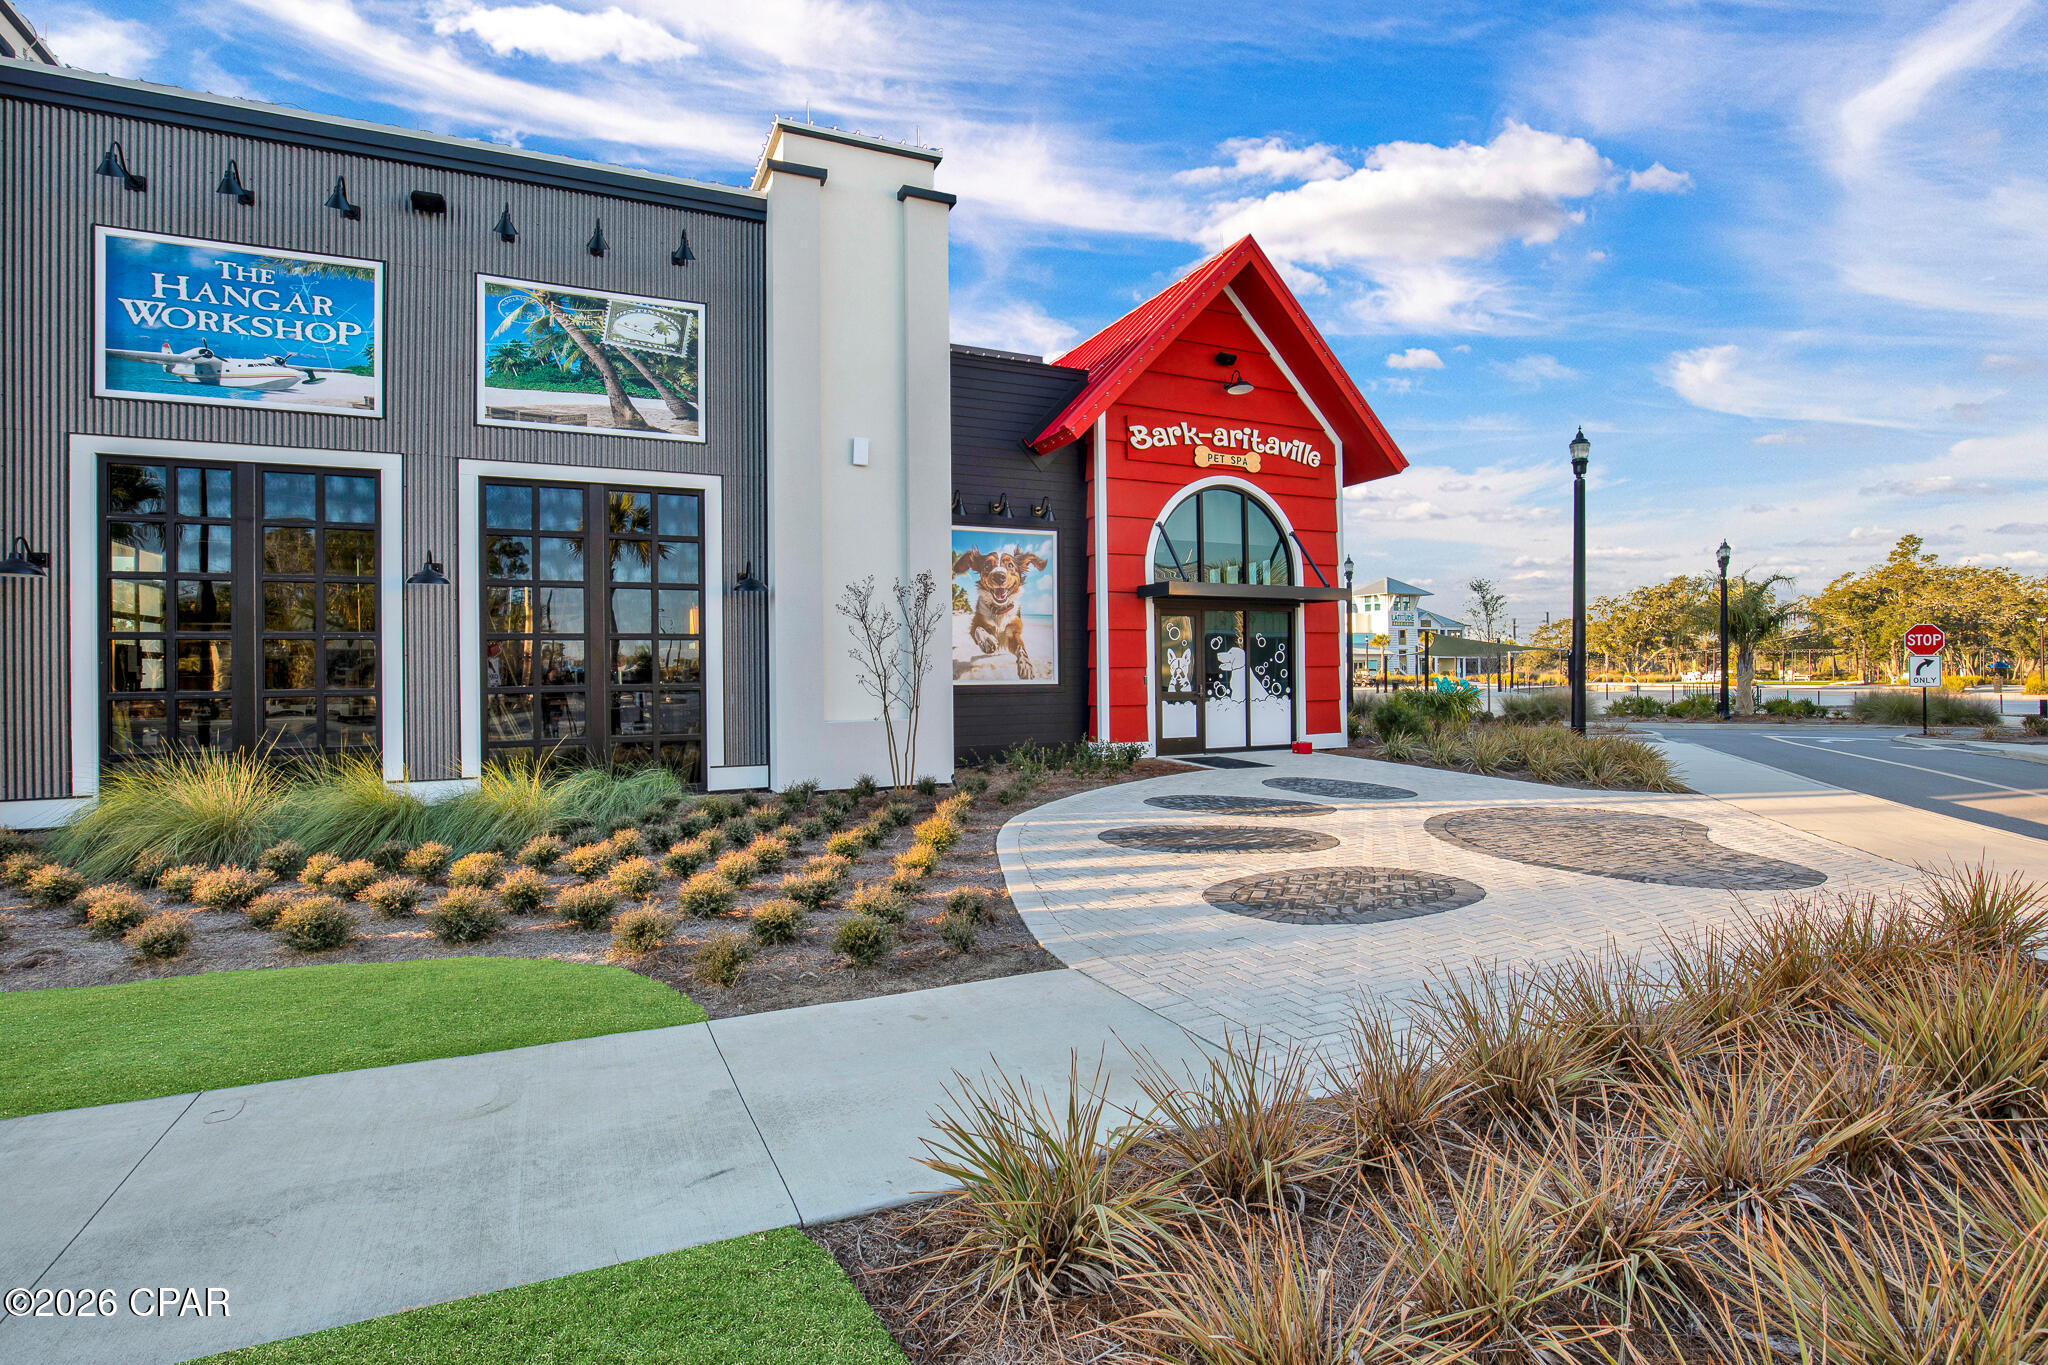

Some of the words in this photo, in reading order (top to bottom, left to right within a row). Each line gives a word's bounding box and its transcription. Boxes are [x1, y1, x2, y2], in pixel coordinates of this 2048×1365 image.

[214, 260, 276, 285] THE
[151, 272, 334, 317] HANGAR
[118, 297, 362, 346] WORKSHOP
[1129, 422, 1321, 468] Bark-aritaville
[1207, 453, 1225, 464] PET
[1230, 455, 1248, 466] SPA
[1907, 634, 1942, 646] STOP
